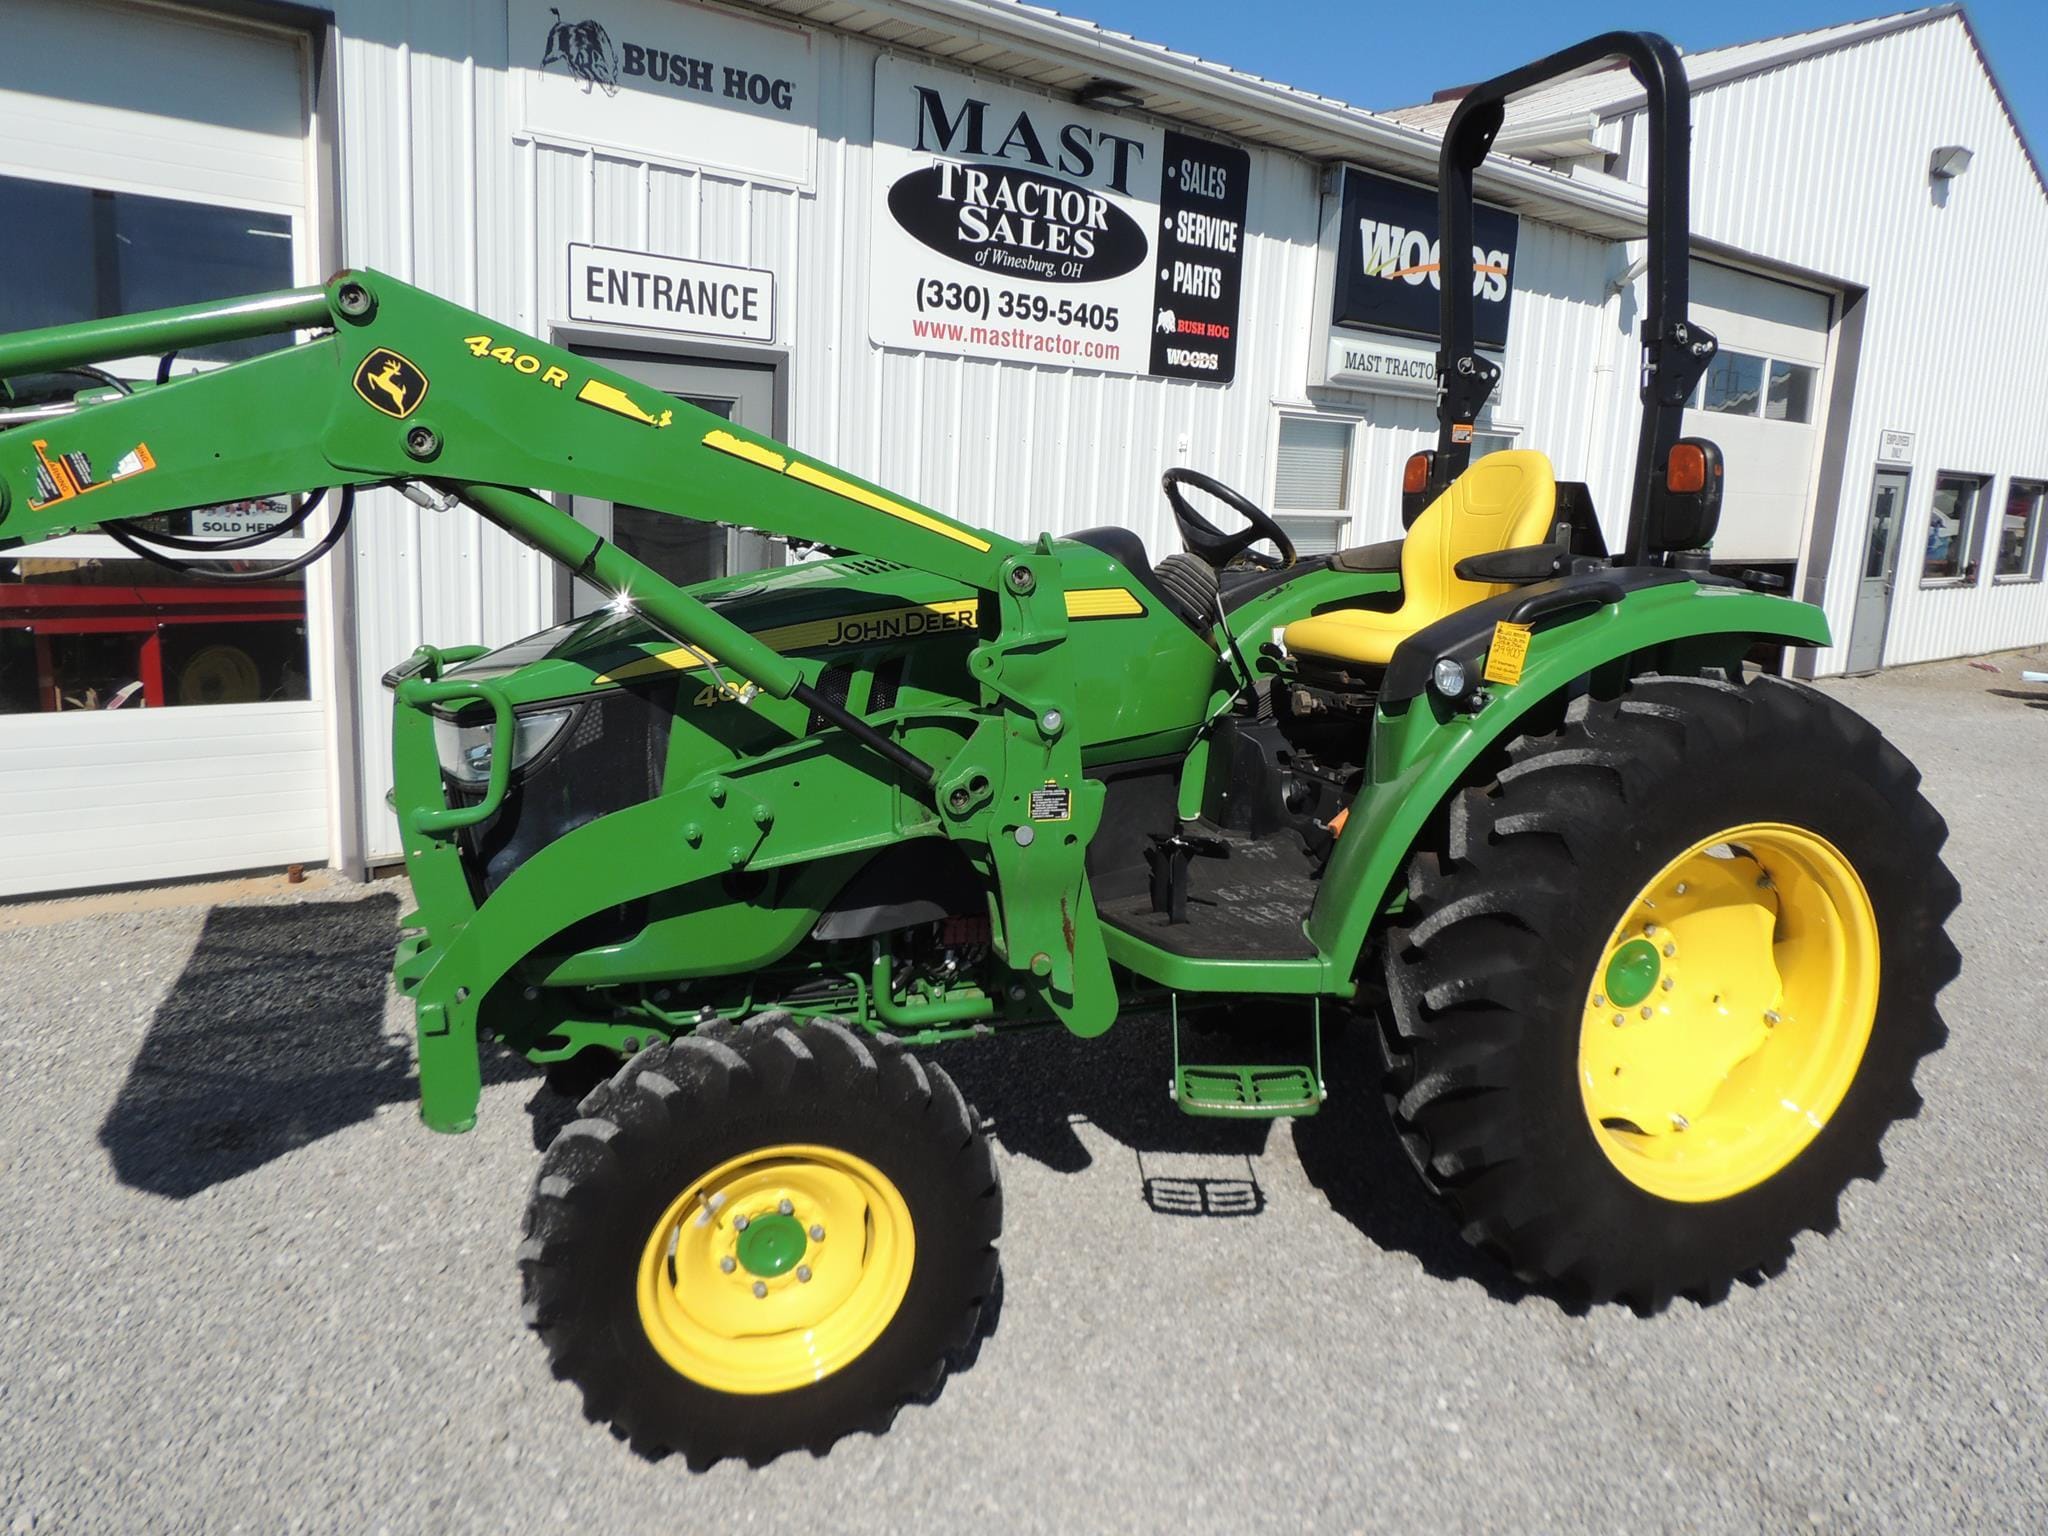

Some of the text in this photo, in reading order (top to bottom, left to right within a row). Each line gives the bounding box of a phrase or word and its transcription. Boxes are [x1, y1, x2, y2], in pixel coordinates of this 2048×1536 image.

[622, 42, 793, 111] BUSH HOG
[912, 85, 1144, 198] MAST
[933, 159, 1109, 231] TRACTOR
[1180, 158, 1227, 200] SALES
[958, 204, 1096, 258] SALES
[1176, 209, 1238, 254] SERVICE
[975, 247, 1083, 279] of Winesburg, OH
[1173, 261, 1222, 300] PARTS
[587, 265, 758, 322] ENTRANCE
[916, 278, 1119, 332] (330) 359-5405
[913, 319, 1120, 360] www.masttractor.com
[1177, 319, 1230, 339] BUSH HOG
[1166, 348, 1219, 370] WOODS
[1345, 351, 1437, 381] MAST TRACTO
[203, 522, 281, 533] SOLD HER
[828, 610, 978, 645] JOHN DEER
